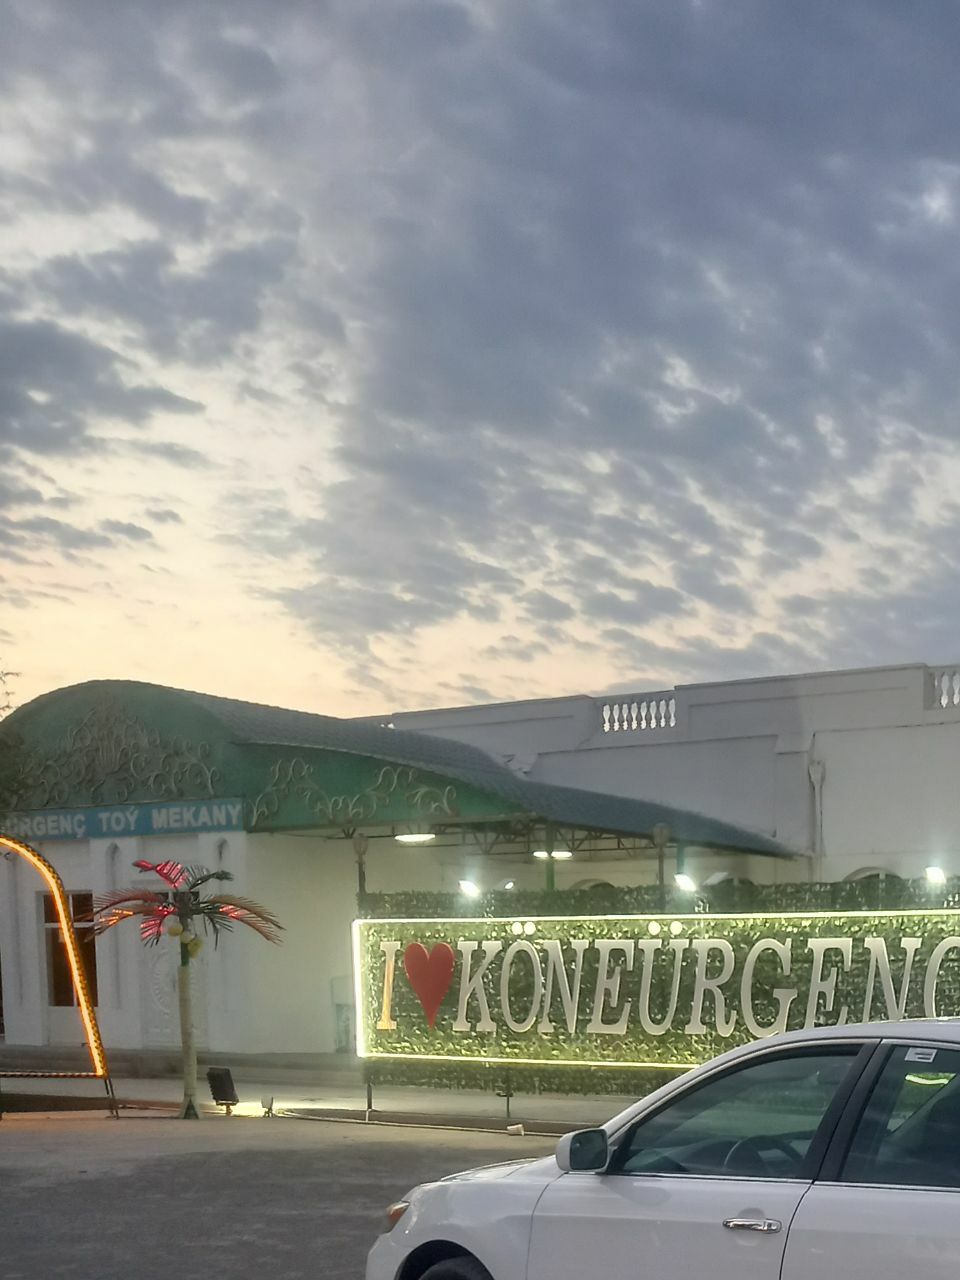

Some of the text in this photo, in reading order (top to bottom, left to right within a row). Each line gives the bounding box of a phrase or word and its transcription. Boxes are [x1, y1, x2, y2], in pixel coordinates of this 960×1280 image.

[98, 807, 139, 833] TOÝ
[152, 803, 242, 830] MEKANY
[376, 940, 401, 1031] I
